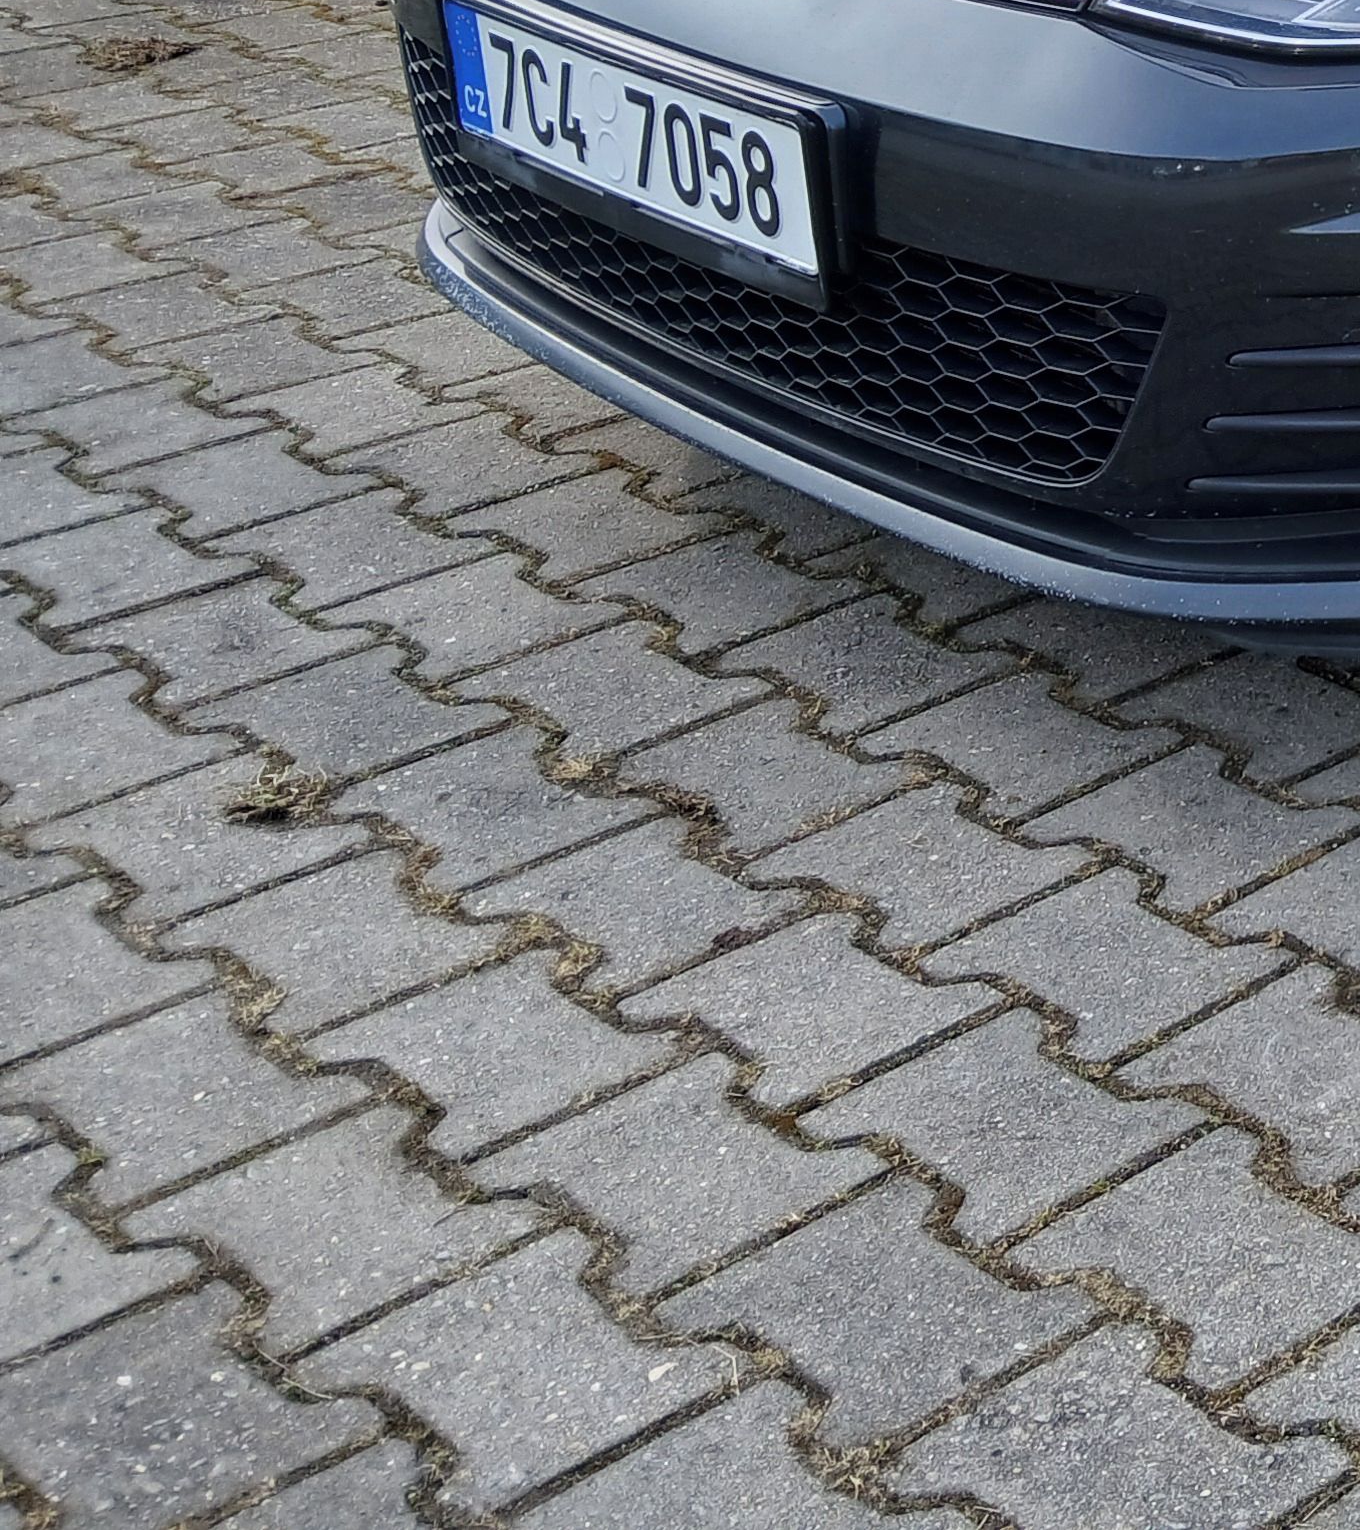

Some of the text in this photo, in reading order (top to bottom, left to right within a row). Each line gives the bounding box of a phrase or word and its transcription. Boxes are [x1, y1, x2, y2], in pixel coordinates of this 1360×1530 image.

[463, 30, 782, 238] CZ 7C4 7058
